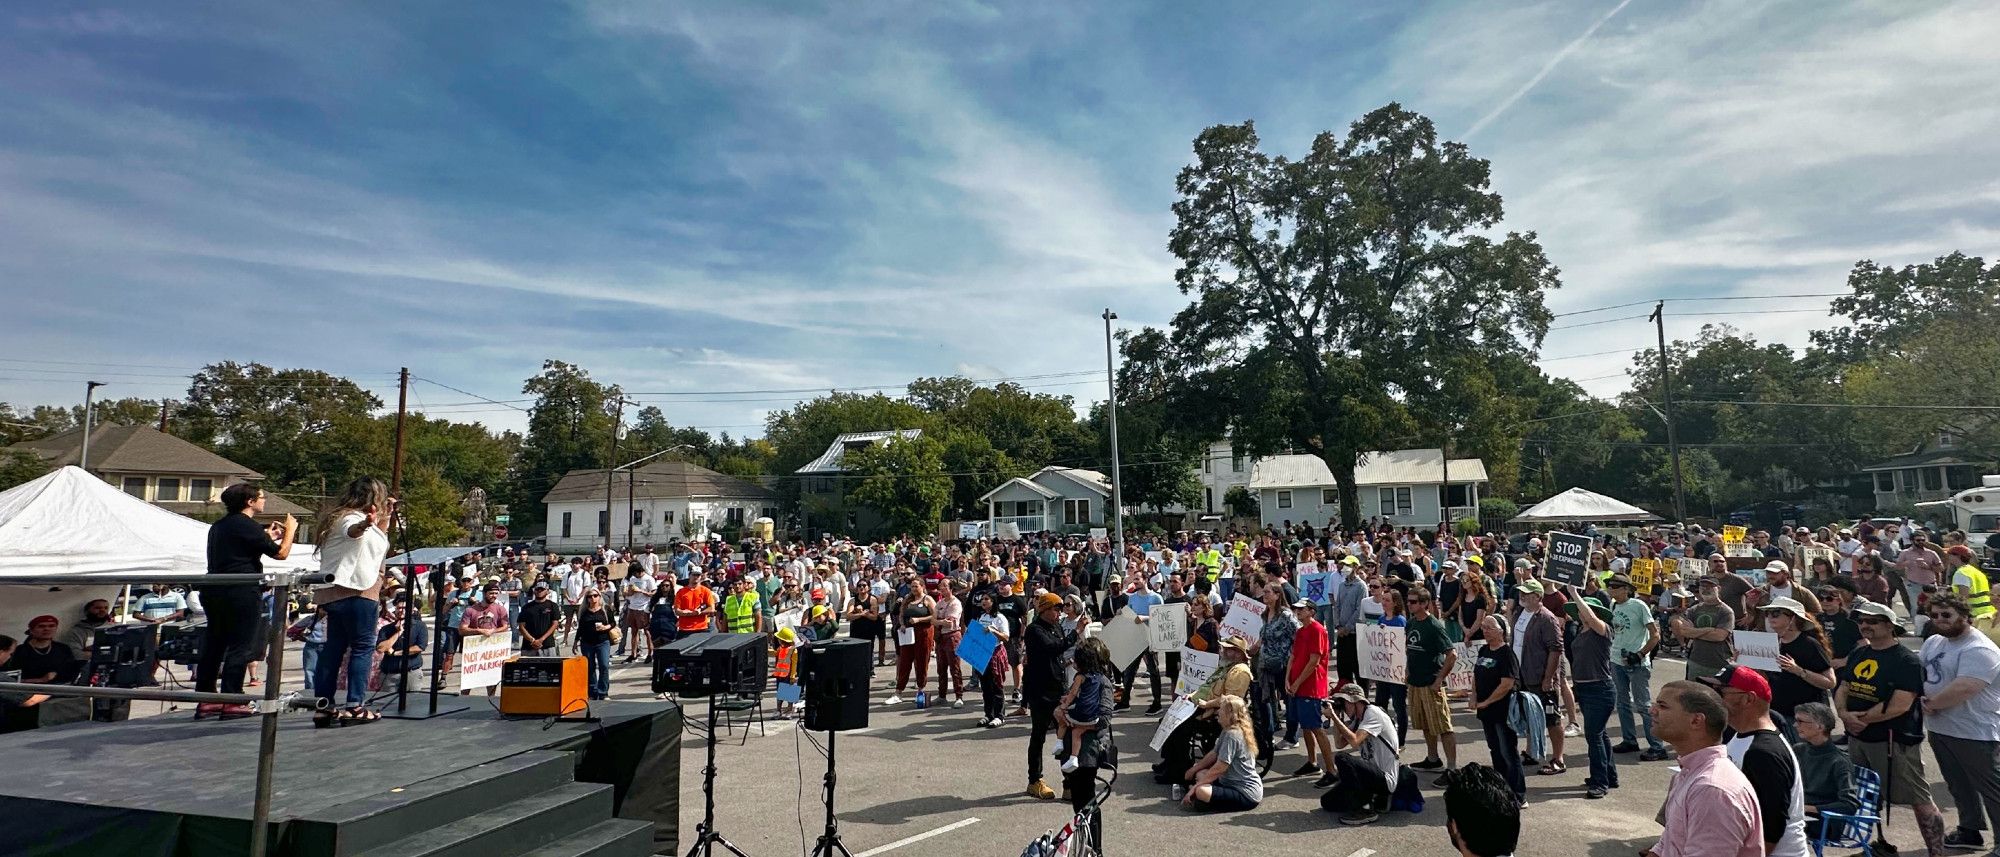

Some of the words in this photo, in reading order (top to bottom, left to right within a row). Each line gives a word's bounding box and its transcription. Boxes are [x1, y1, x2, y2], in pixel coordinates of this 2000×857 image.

[1555, 541, 1582, 556] STOP
[1559, 555, 1585, 566] EXPANSION
[1685, 559, 1704, 568] CITIES
[1632, 575, 1649, 585] OUR
[1157, 610, 1172, 623] ONE
[1157, 621, 1176, 632] MORE
[1365, 631, 1401, 653] WIDER
[463, 651, 479, 663] NOT
[480, 647, 510, 661] ALRIGHT
[463, 664, 478, 675] NOT
[477, 659, 503, 673] ALRIGH
[1446, 670, 1473, 688] TRAFF
